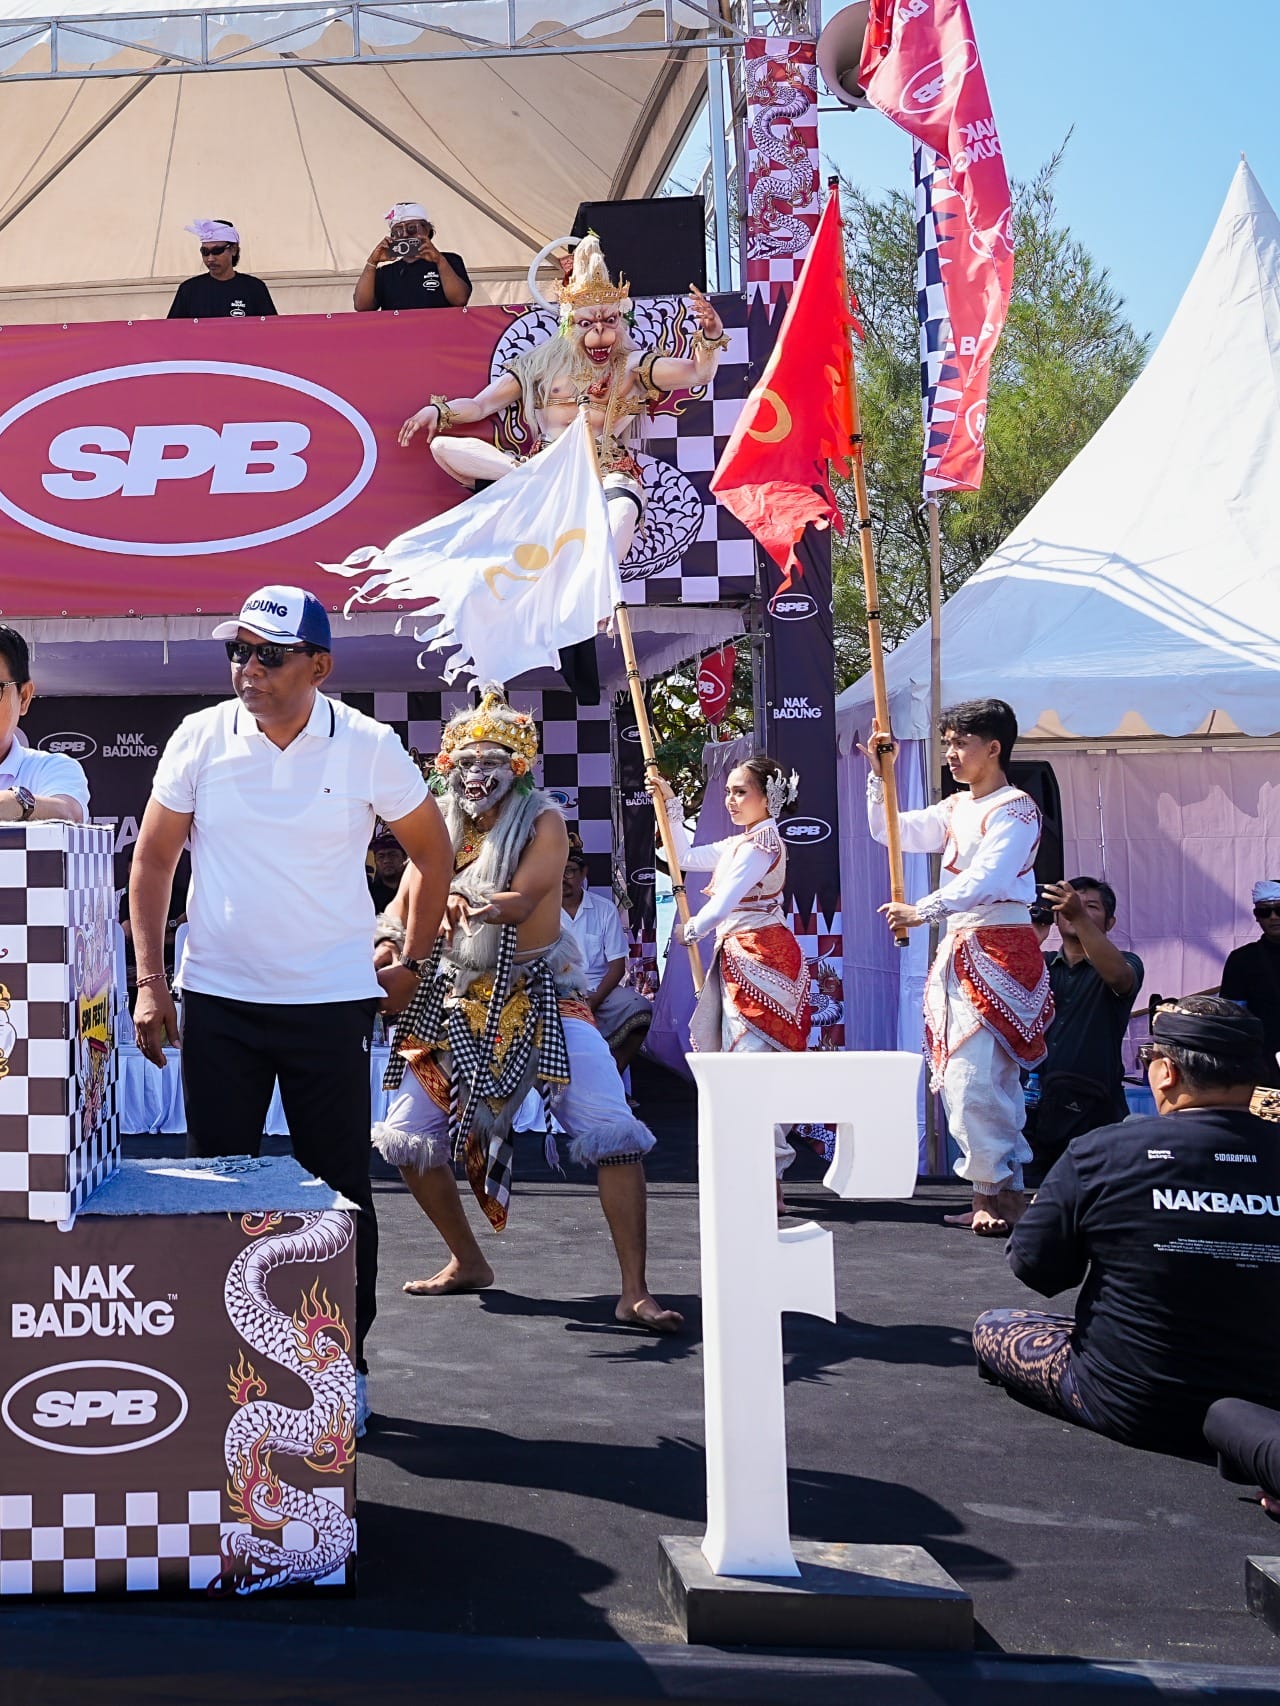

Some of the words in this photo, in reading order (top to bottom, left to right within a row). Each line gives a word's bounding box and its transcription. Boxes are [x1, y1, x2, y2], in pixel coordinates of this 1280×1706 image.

[42, 421, 311, 499] SPB
[776, 602, 809, 612] SPB
[784, 697, 808, 708] NAK
[774, 707, 822, 719] BADUNG
[117, 734, 144, 745] NAK
[628, 730, 641, 738] SP
[49, 742, 86, 752] SPB
[103, 746, 158, 757] BADUNG
[786, 826, 820, 836] SPB
[1152, 1189, 1280, 1216] NAKBADU
[54, 1264, 135, 1300] NAK
[11, 1301, 174, 1338] BADUNG
[686, 1051, 924, 1577] F
[33, 1390, 158, 1427] SPB
